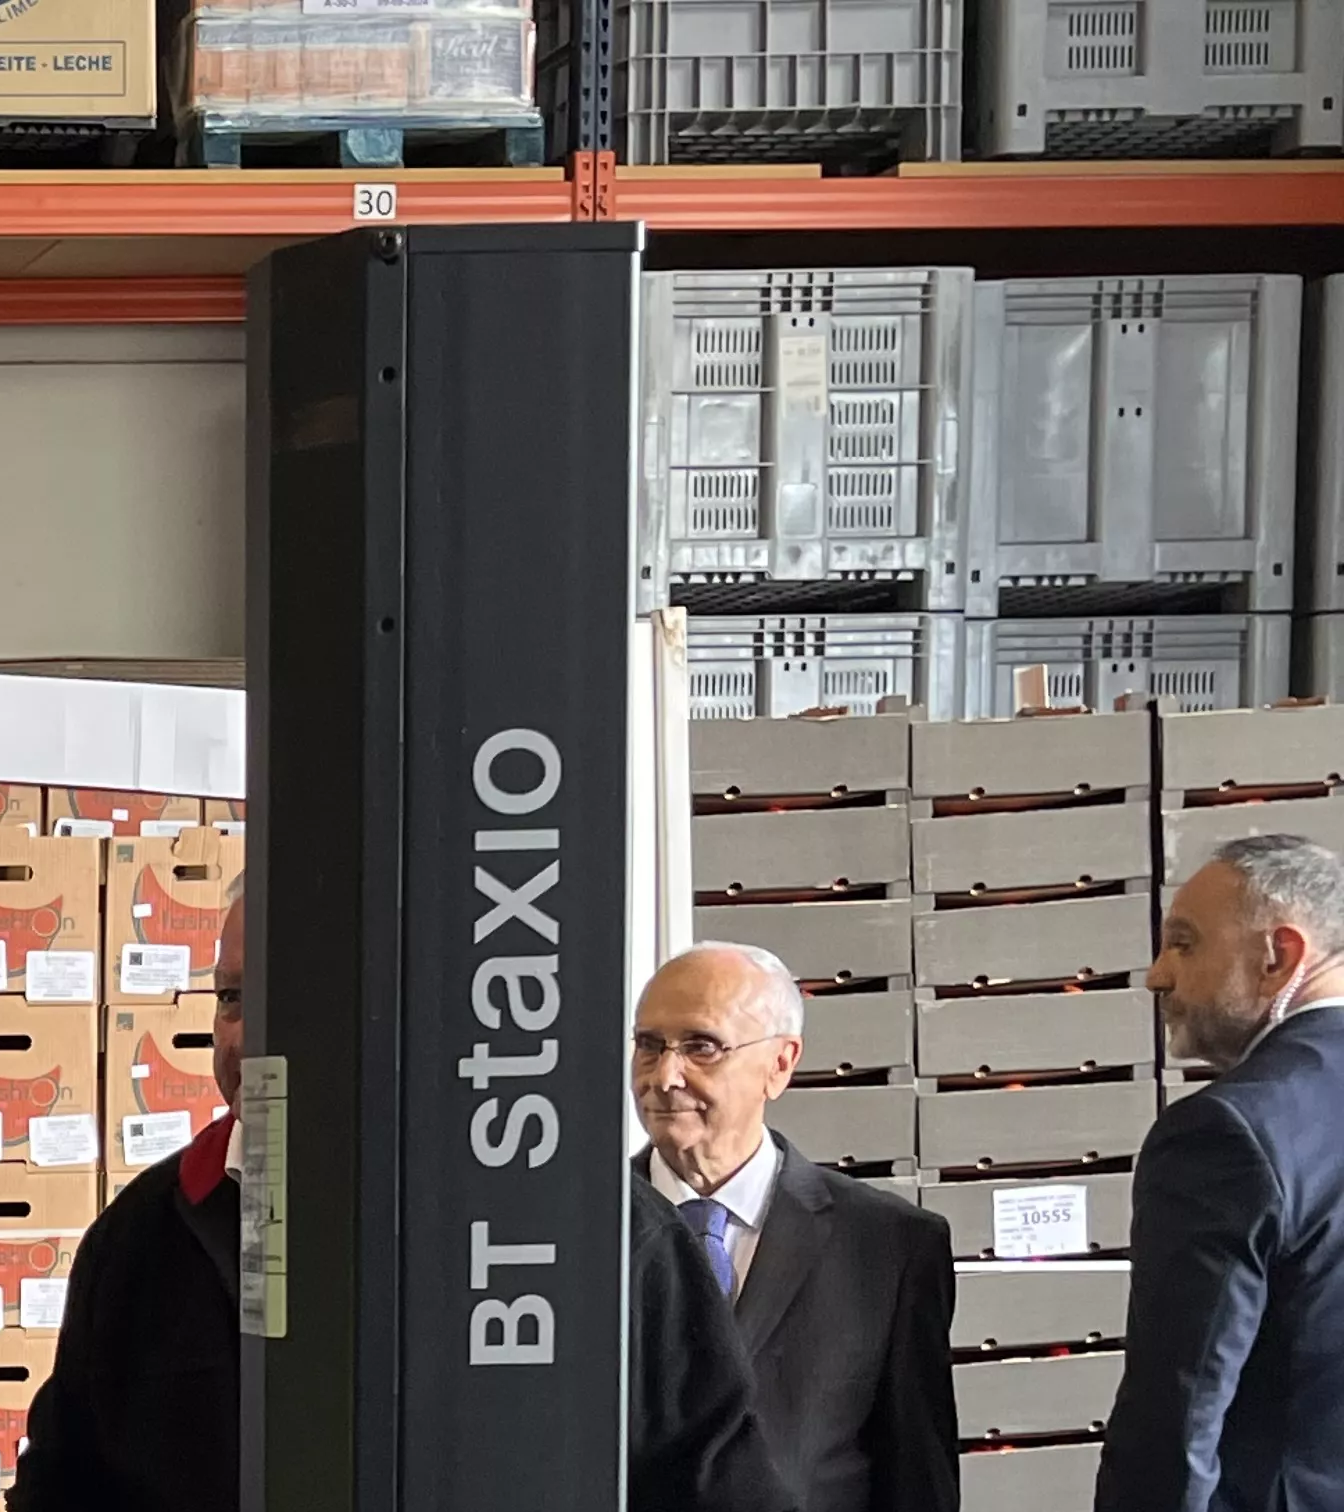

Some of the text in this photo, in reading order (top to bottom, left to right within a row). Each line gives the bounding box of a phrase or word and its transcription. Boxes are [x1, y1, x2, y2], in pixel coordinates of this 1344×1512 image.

[52, 55, 113, 71] LECHE
[357, 189, 394, 217] 30
[1021, 1208, 1072, 1226] 10555
[469, 1221, 556, 1366] BT
